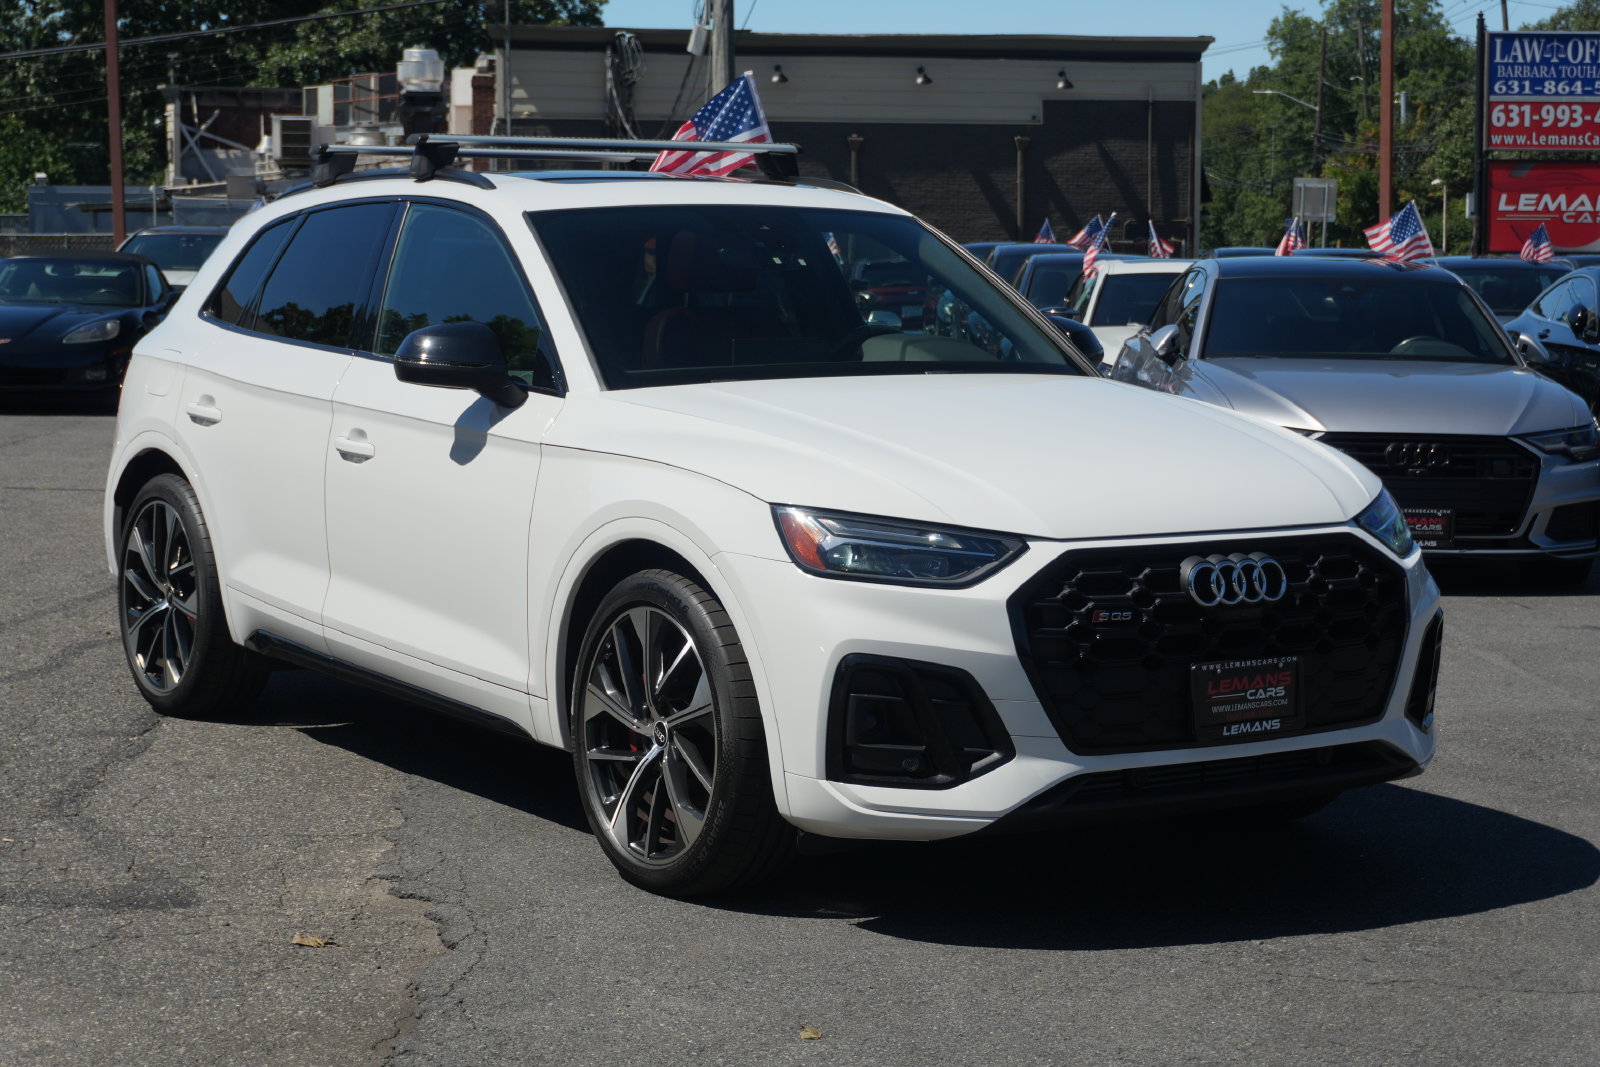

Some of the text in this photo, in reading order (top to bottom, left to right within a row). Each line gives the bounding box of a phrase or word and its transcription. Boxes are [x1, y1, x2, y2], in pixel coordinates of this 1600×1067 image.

[1494, 38, 1600, 64] LAW OF
[1496, 65, 1557, 78] BARBARA
[1498, 193, 1600, 211] LEMA
[1406, 517, 1447, 525] MANS
[1098, 612, 1133, 621] SQ5
[1202, 656, 1297, 671] WWW.LEMANSCARS.COM
[1207, 672, 1293, 694] LEMANS
[1246, 686, 1286, 700] CARS
[1211, 698, 1288, 713] WWW.LEMANSCARS.COM
[1222, 719, 1281, 736] LEMANS
